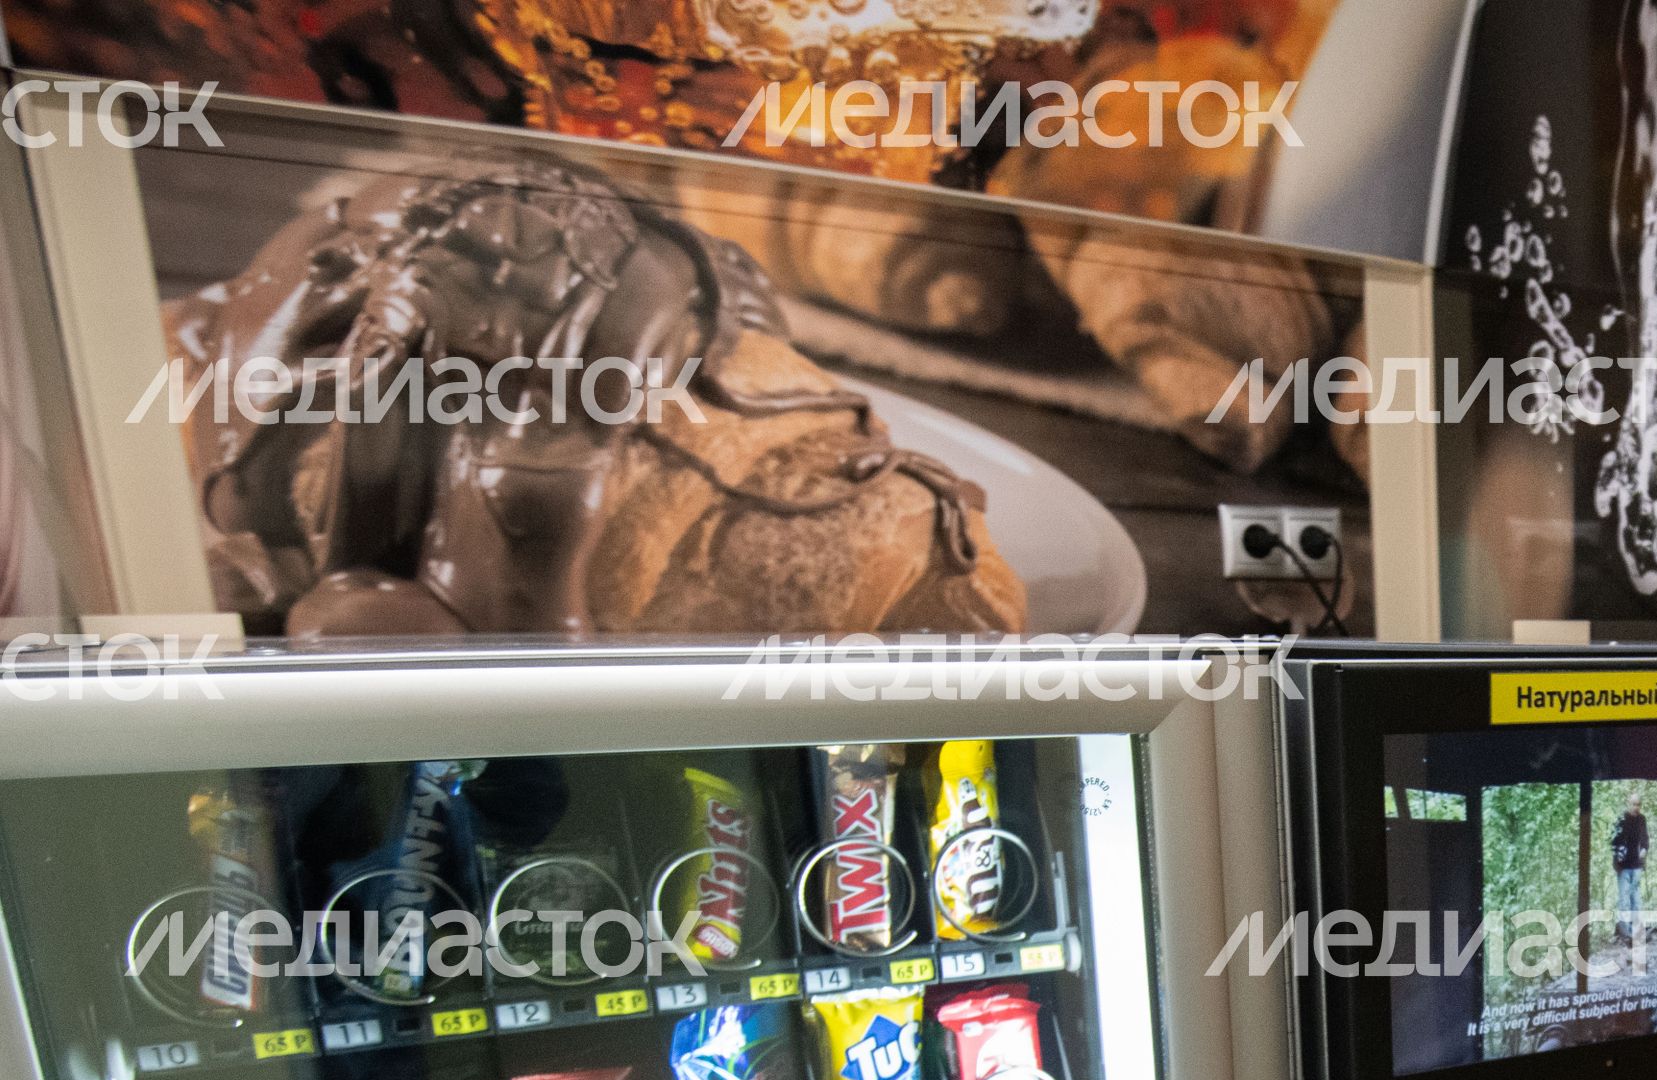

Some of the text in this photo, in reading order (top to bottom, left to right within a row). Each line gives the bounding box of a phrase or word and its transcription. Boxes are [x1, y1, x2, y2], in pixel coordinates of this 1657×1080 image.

[830, 788, 886, 945] TWIX
[896, 963, 917, 980] 65
[951, 953, 977, 974] 15
[759, 978, 781, 997] 65
[814, 968, 843, 989] 14
[667, 984, 698, 1006] 13
[1482, 1003, 1506, 1020] And
[1509, 1001, 1534, 1015] now
[1538, 997, 1547, 1011] it
[1550, 995, 1569, 1010] has
[1573, 989, 1624, 1009] sprouted
[440, 1014, 465, 1032] 65
[508, 1003, 539, 1025] 12
[1467, 1022, 1476, 1037] It
[1479, 1019, 1489, 1034] is
[1491, 1021, 1500, 1032] a
[1504, 1016, 1530, 1033] very
[1533, 1006, 1576, 1027] difficult
[1579, 1003, 1620, 1021] subject
[1623, 998, 1639, 1013] for
[1641, 996, 1657, 1010] the
[263, 1036, 289, 1054] 65
[338, 1022, 367, 1046] 11
[150, 1043, 189, 1067] 10
